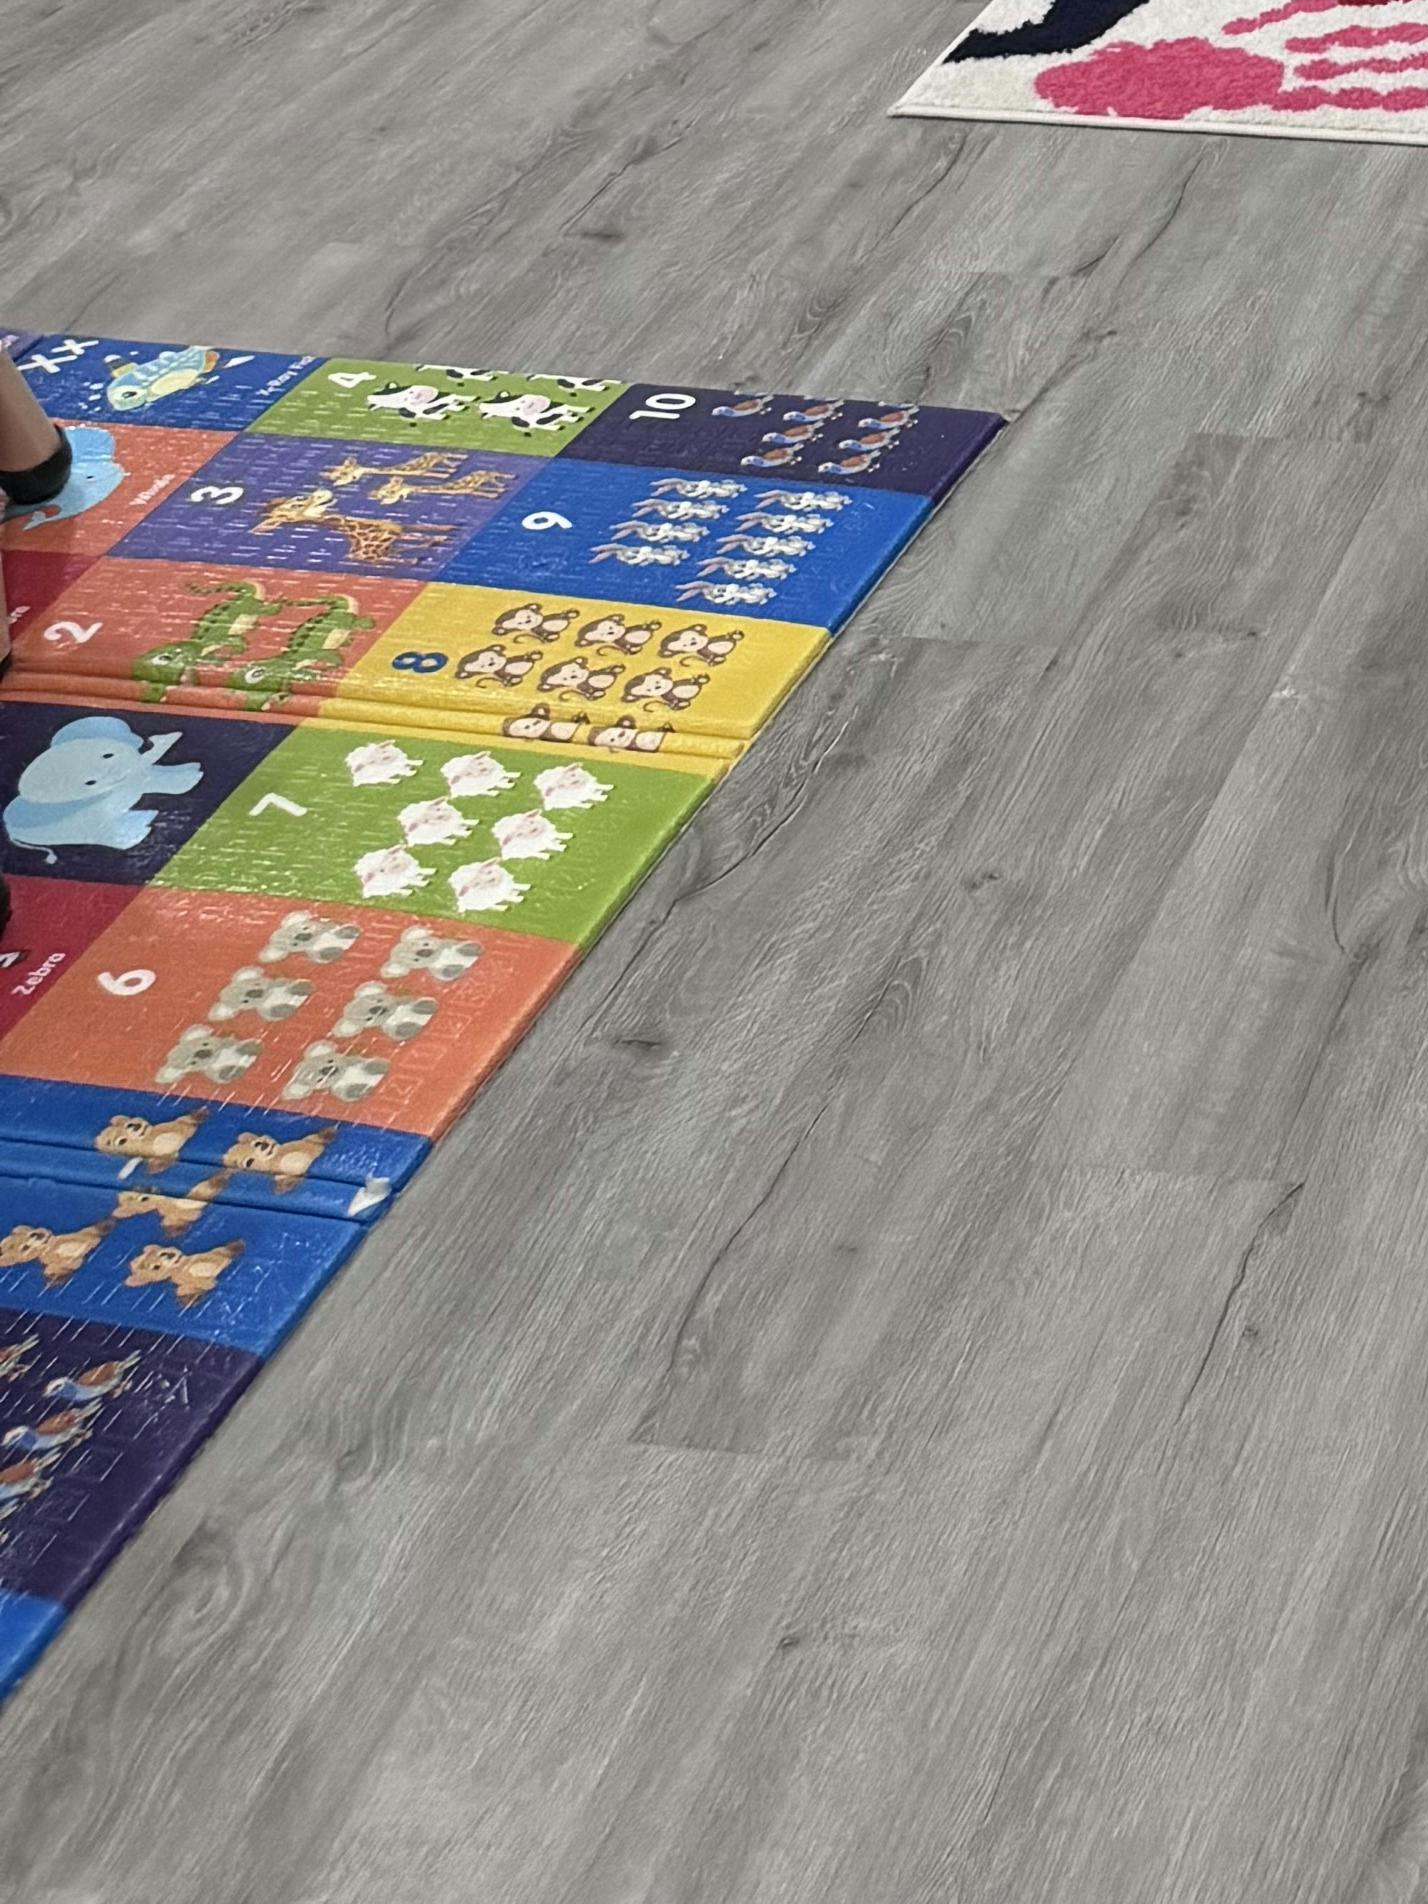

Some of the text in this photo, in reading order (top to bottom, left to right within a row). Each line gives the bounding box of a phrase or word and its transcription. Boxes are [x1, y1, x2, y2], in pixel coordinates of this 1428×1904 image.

[17, 339, 99, 374] Xx
[327, 371, 377, 389] 4
[629, 392, 697, 421] 10
[189, 485, 244, 505] 3
[521, 510, 573, 531] 9
[43, 620, 104, 645] 2
[391, 650, 449, 674] 8
[248, 791, 308, 817] 7
[97, 968, 157, 997] 6
